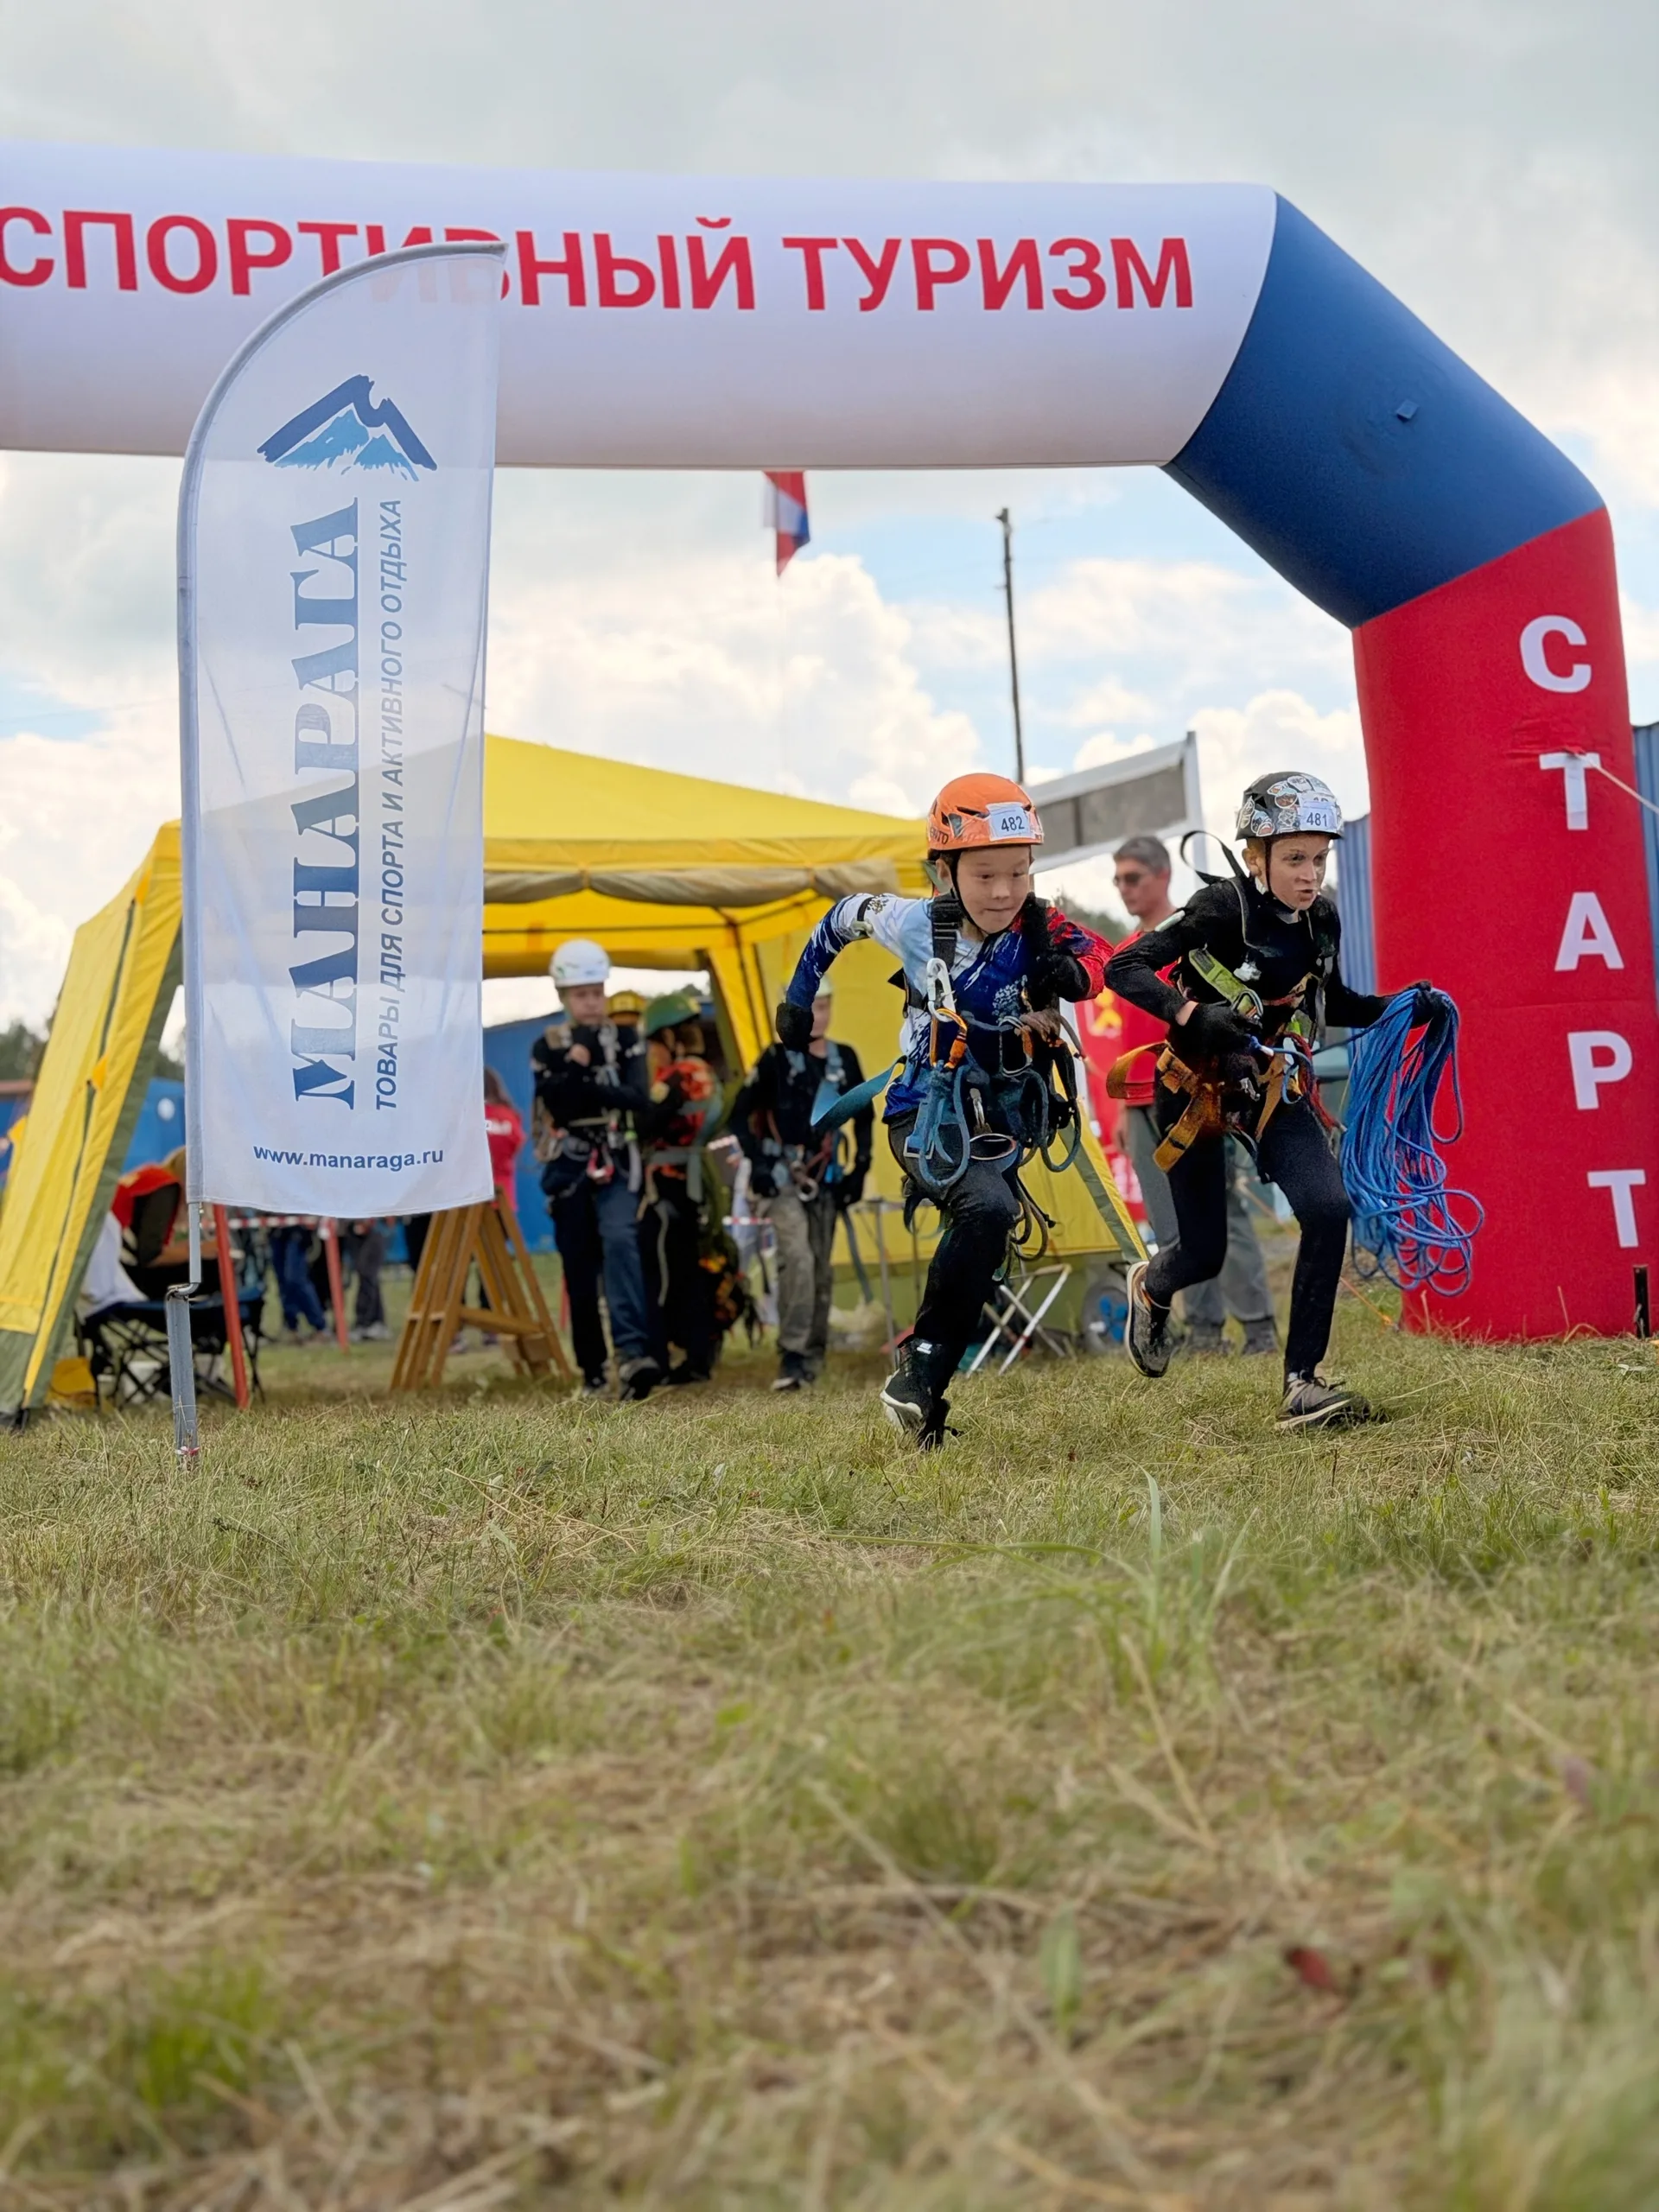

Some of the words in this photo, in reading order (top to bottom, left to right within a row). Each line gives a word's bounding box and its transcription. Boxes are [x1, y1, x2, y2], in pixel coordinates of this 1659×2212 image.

[783, 238, 1192, 311] ТУРИЗМ
[379, 500, 407, 613] ОТДЫХА
[380, 621, 404, 787] АКТИВНОГО
[289, 497, 359, 1110] МАНАРАГА
[381, 791, 404, 812] И
[1001, 816, 1026, 832] 482
[1306, 812, 1328, 828] 481
[380, 821, 405, 925] СПОРТА
[379, 933, 408, 993] ДЛЯ
[1519, 614, 1647, 1249] СТАРТ
[375, 996, 401, 1110] ТОВАРЫ
[252, 1145, 444, 1172] www.manaraga.ru
